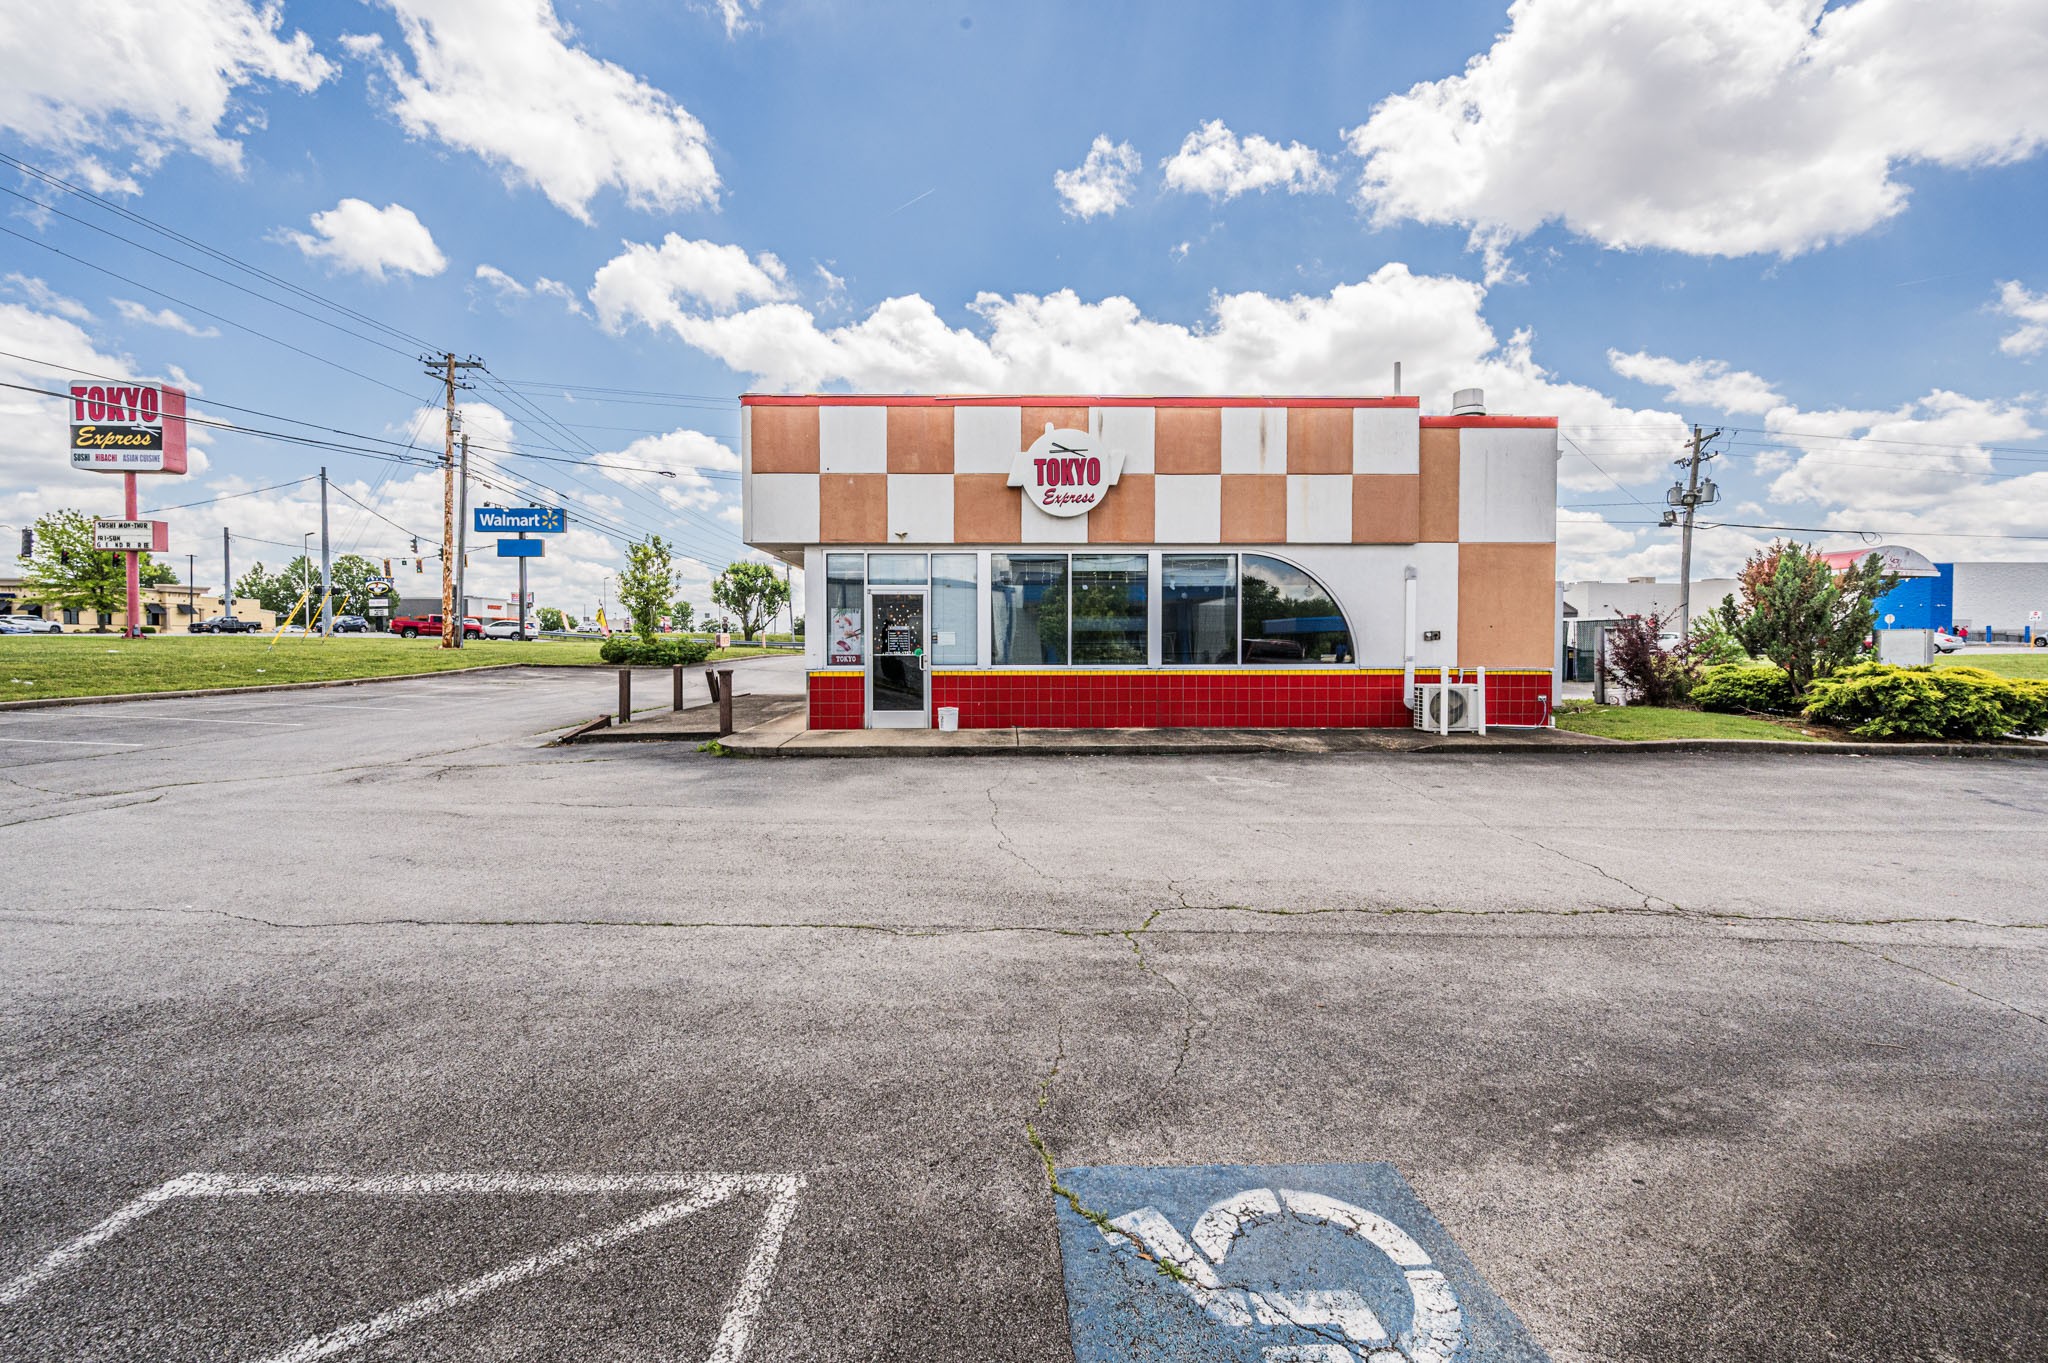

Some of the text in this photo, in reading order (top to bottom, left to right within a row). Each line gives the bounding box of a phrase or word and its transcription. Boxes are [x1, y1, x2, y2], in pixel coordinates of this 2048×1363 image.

[71, 386, 158, 422] TOKYO
[76, 426, 151, 449] Express
[73, 453, 160, 463] SUSHI HIBACHI ASIAN CUISINE
[1034, 457, 1101, 486] TOKYO
[1043, 487, 1095, 507] Express
[480, 514, 540, 526] Walmart
